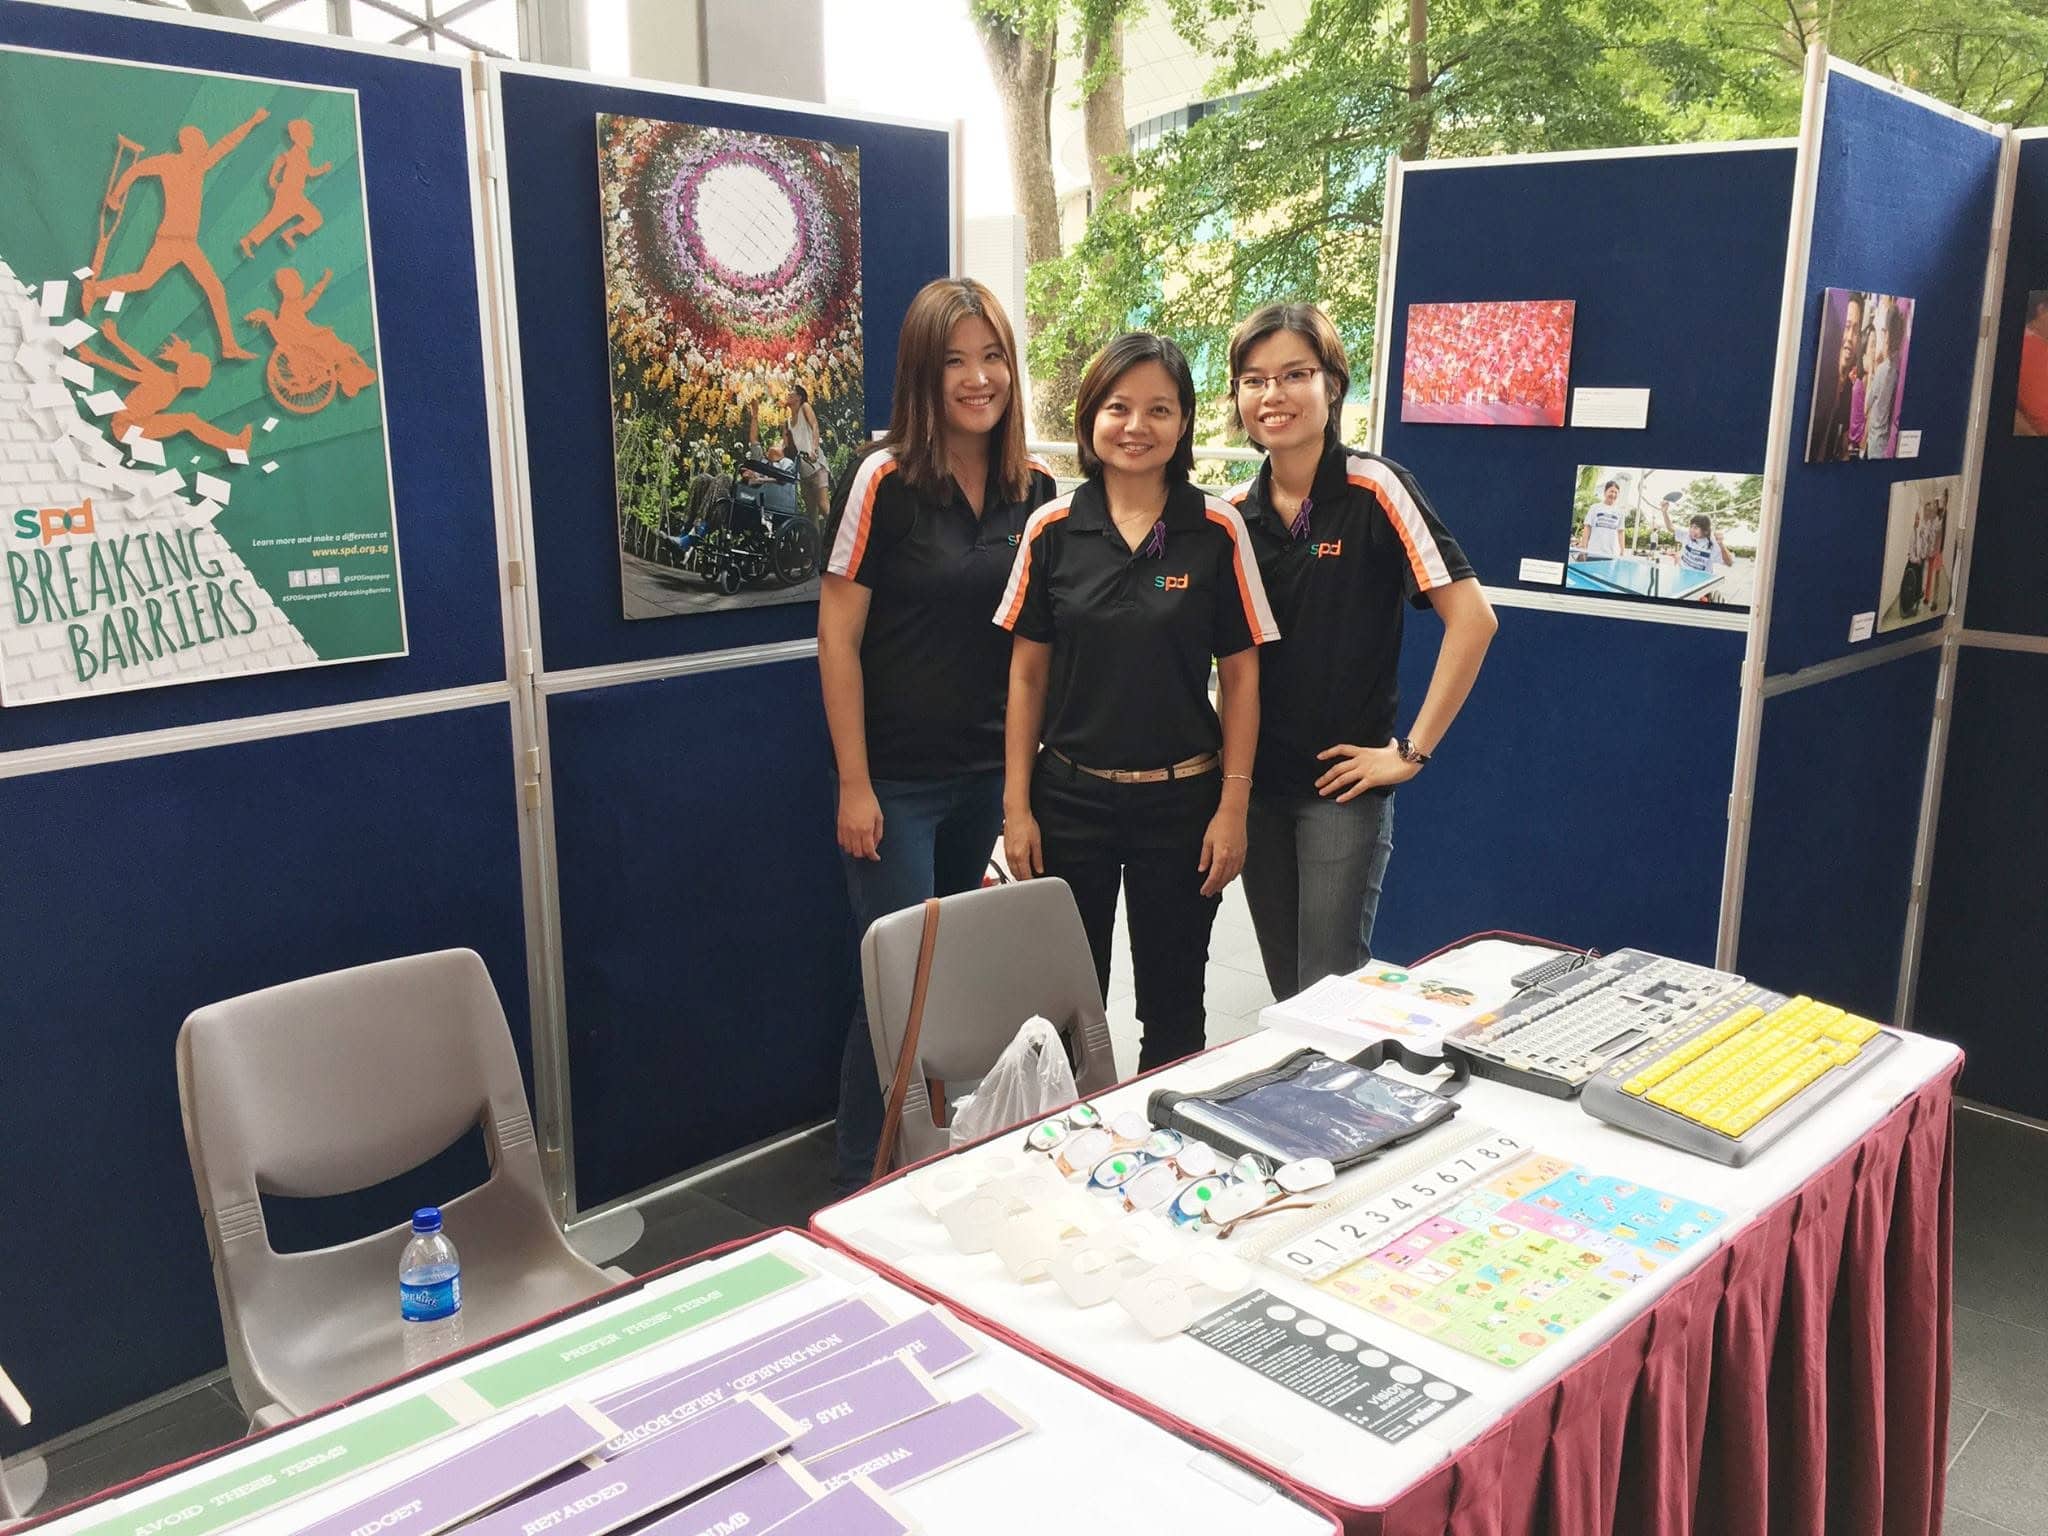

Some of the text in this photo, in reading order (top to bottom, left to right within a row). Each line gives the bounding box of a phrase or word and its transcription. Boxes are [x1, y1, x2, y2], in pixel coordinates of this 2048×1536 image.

[14, 497, 95, 546] spd
[252, 538, 275, 547] Learn
[275, 537, 297, 545] more
[297, 535, 312, 544] and
[313, 533, 334, 542] make
[341, 531, 378, 542] difference
[379, 531, 388, 539] at
[312, 544, 389, 558] www.spd.org.sg
[1309, 539, 1342, 559] spd
[6, 526, 225, 625] BREAKING
[1153, 572, 1189, 592] spd
[67, 578, 258, 682] BARRIERS
[1287, 1137, 1520, 1267] 0 1 2 3 4 5 6 7 8 9
[559, 1289, 725, 1363] PREFER THESE TERMS
[727, 1332, 844, 1391] NON-DISABLED,
[815, 1401, 855, 1425] HAS
[135, 1444, 348, 1536] AVOID THESE TERMS
[521, 1481, 629, 1536] RETARDED
[696, 1511, 750, 1536] UMB
